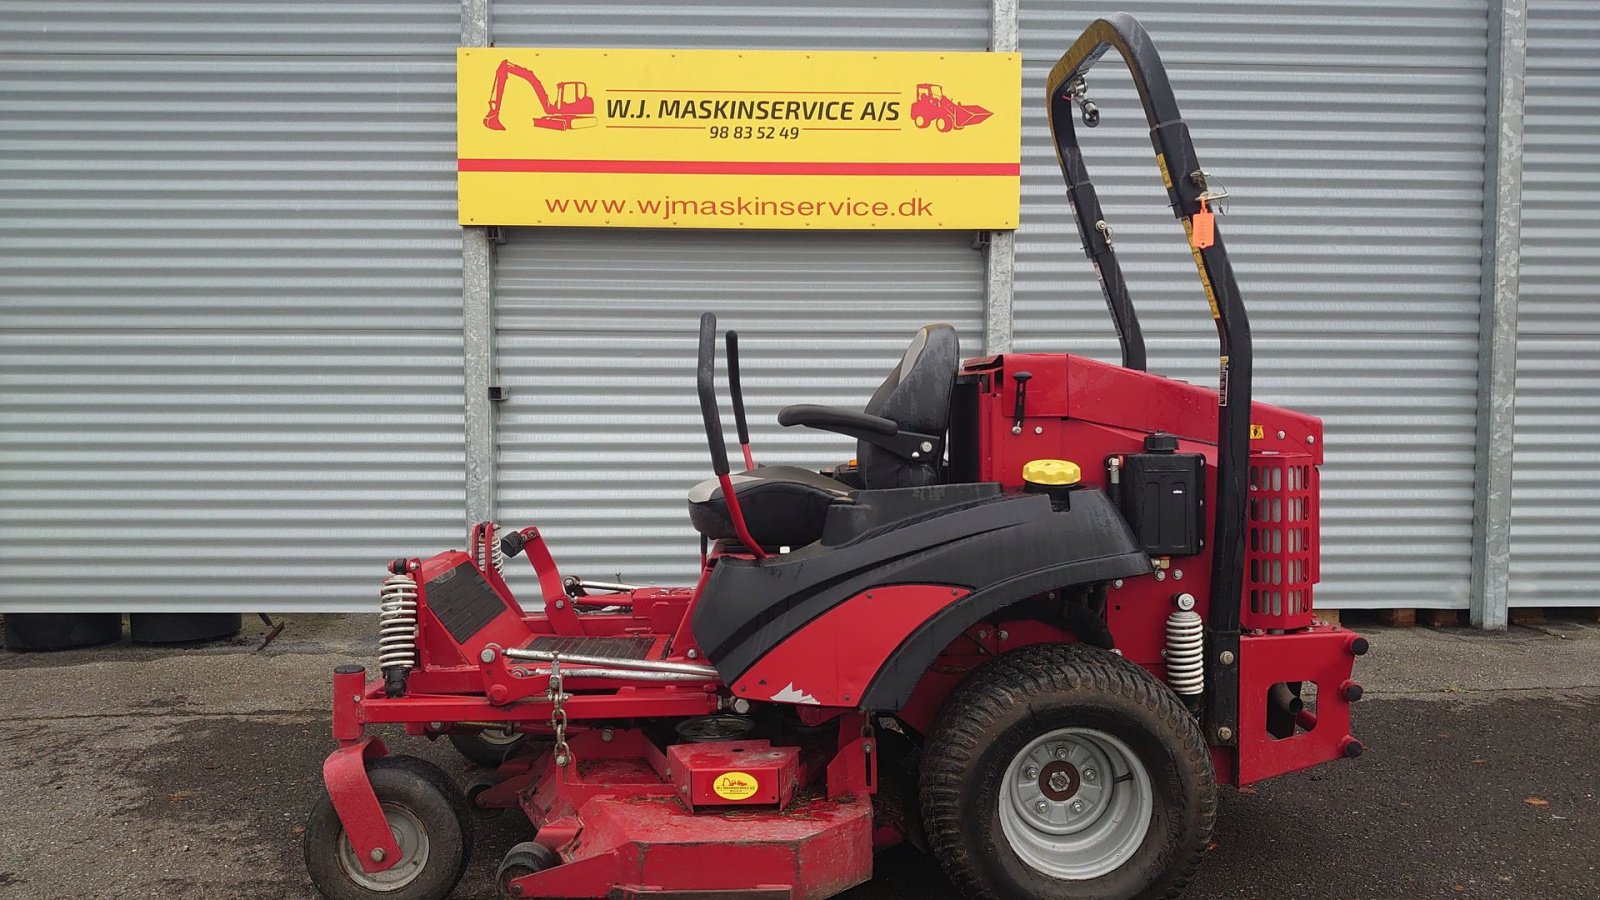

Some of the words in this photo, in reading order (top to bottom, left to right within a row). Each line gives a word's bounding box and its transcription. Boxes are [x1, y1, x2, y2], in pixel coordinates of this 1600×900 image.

[607, 99, 651, 119] W.J.
[658, 99, 855, 121] MASKINSERVICE
[860, 101, 900, 122] A/S
[709, 126, 729, 139] 98
[733, 126, 753, 140] 83
[756, 126, 775, 140] 52
[779, 126, 800, 140] 49
[545, 195, 934, 219] www.wjmaskinservice.dk
